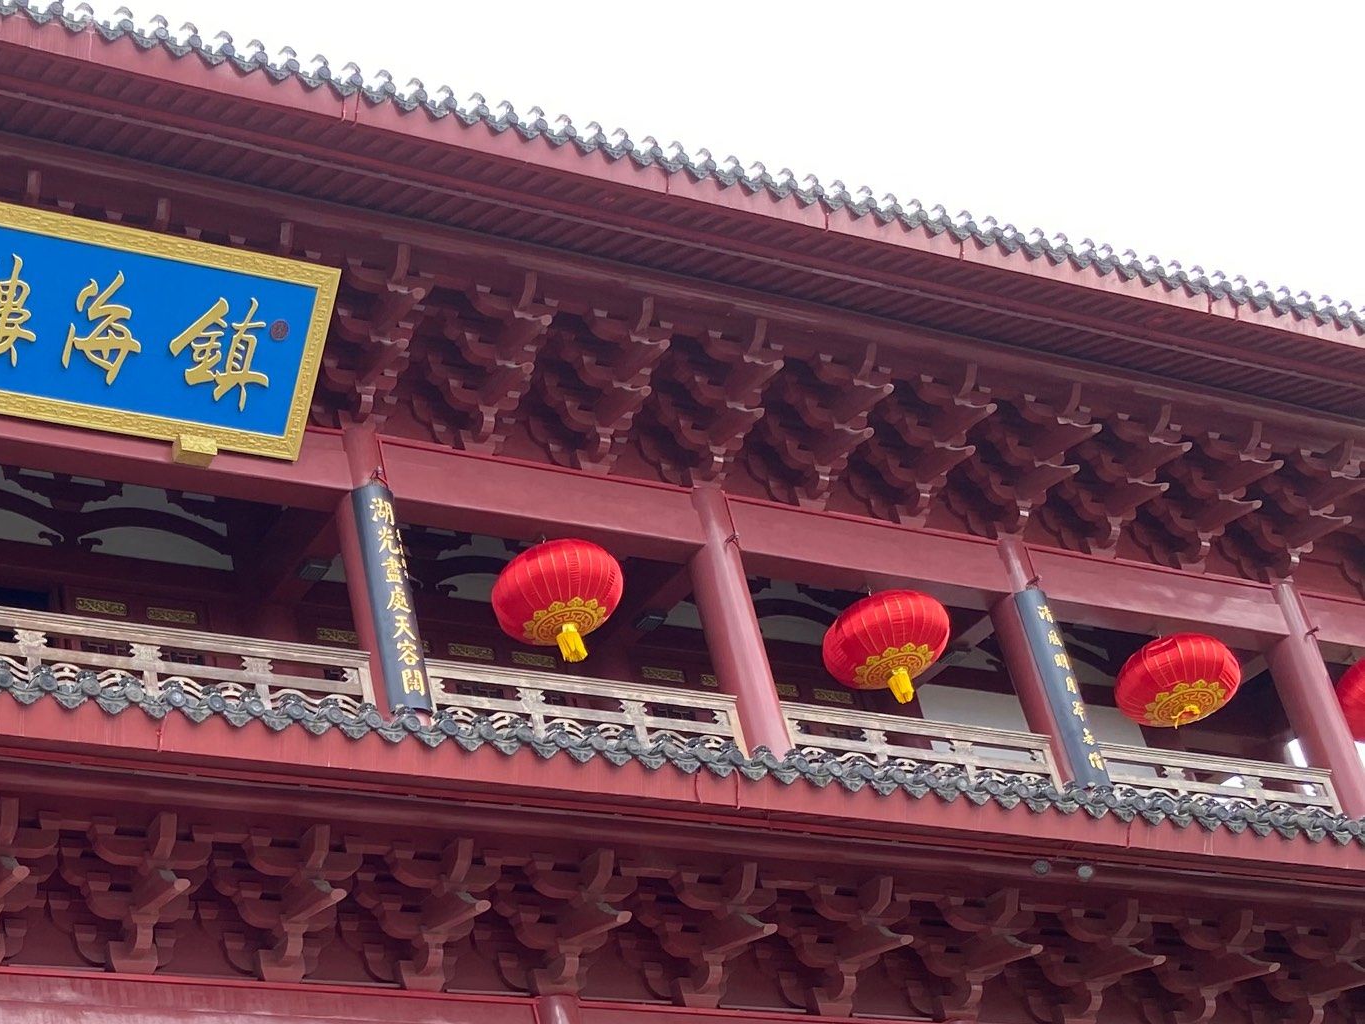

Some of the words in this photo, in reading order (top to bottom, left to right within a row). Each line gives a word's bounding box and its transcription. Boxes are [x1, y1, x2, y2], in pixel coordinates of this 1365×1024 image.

[369, 498, 425, 696] 湖光盡處天容闊
